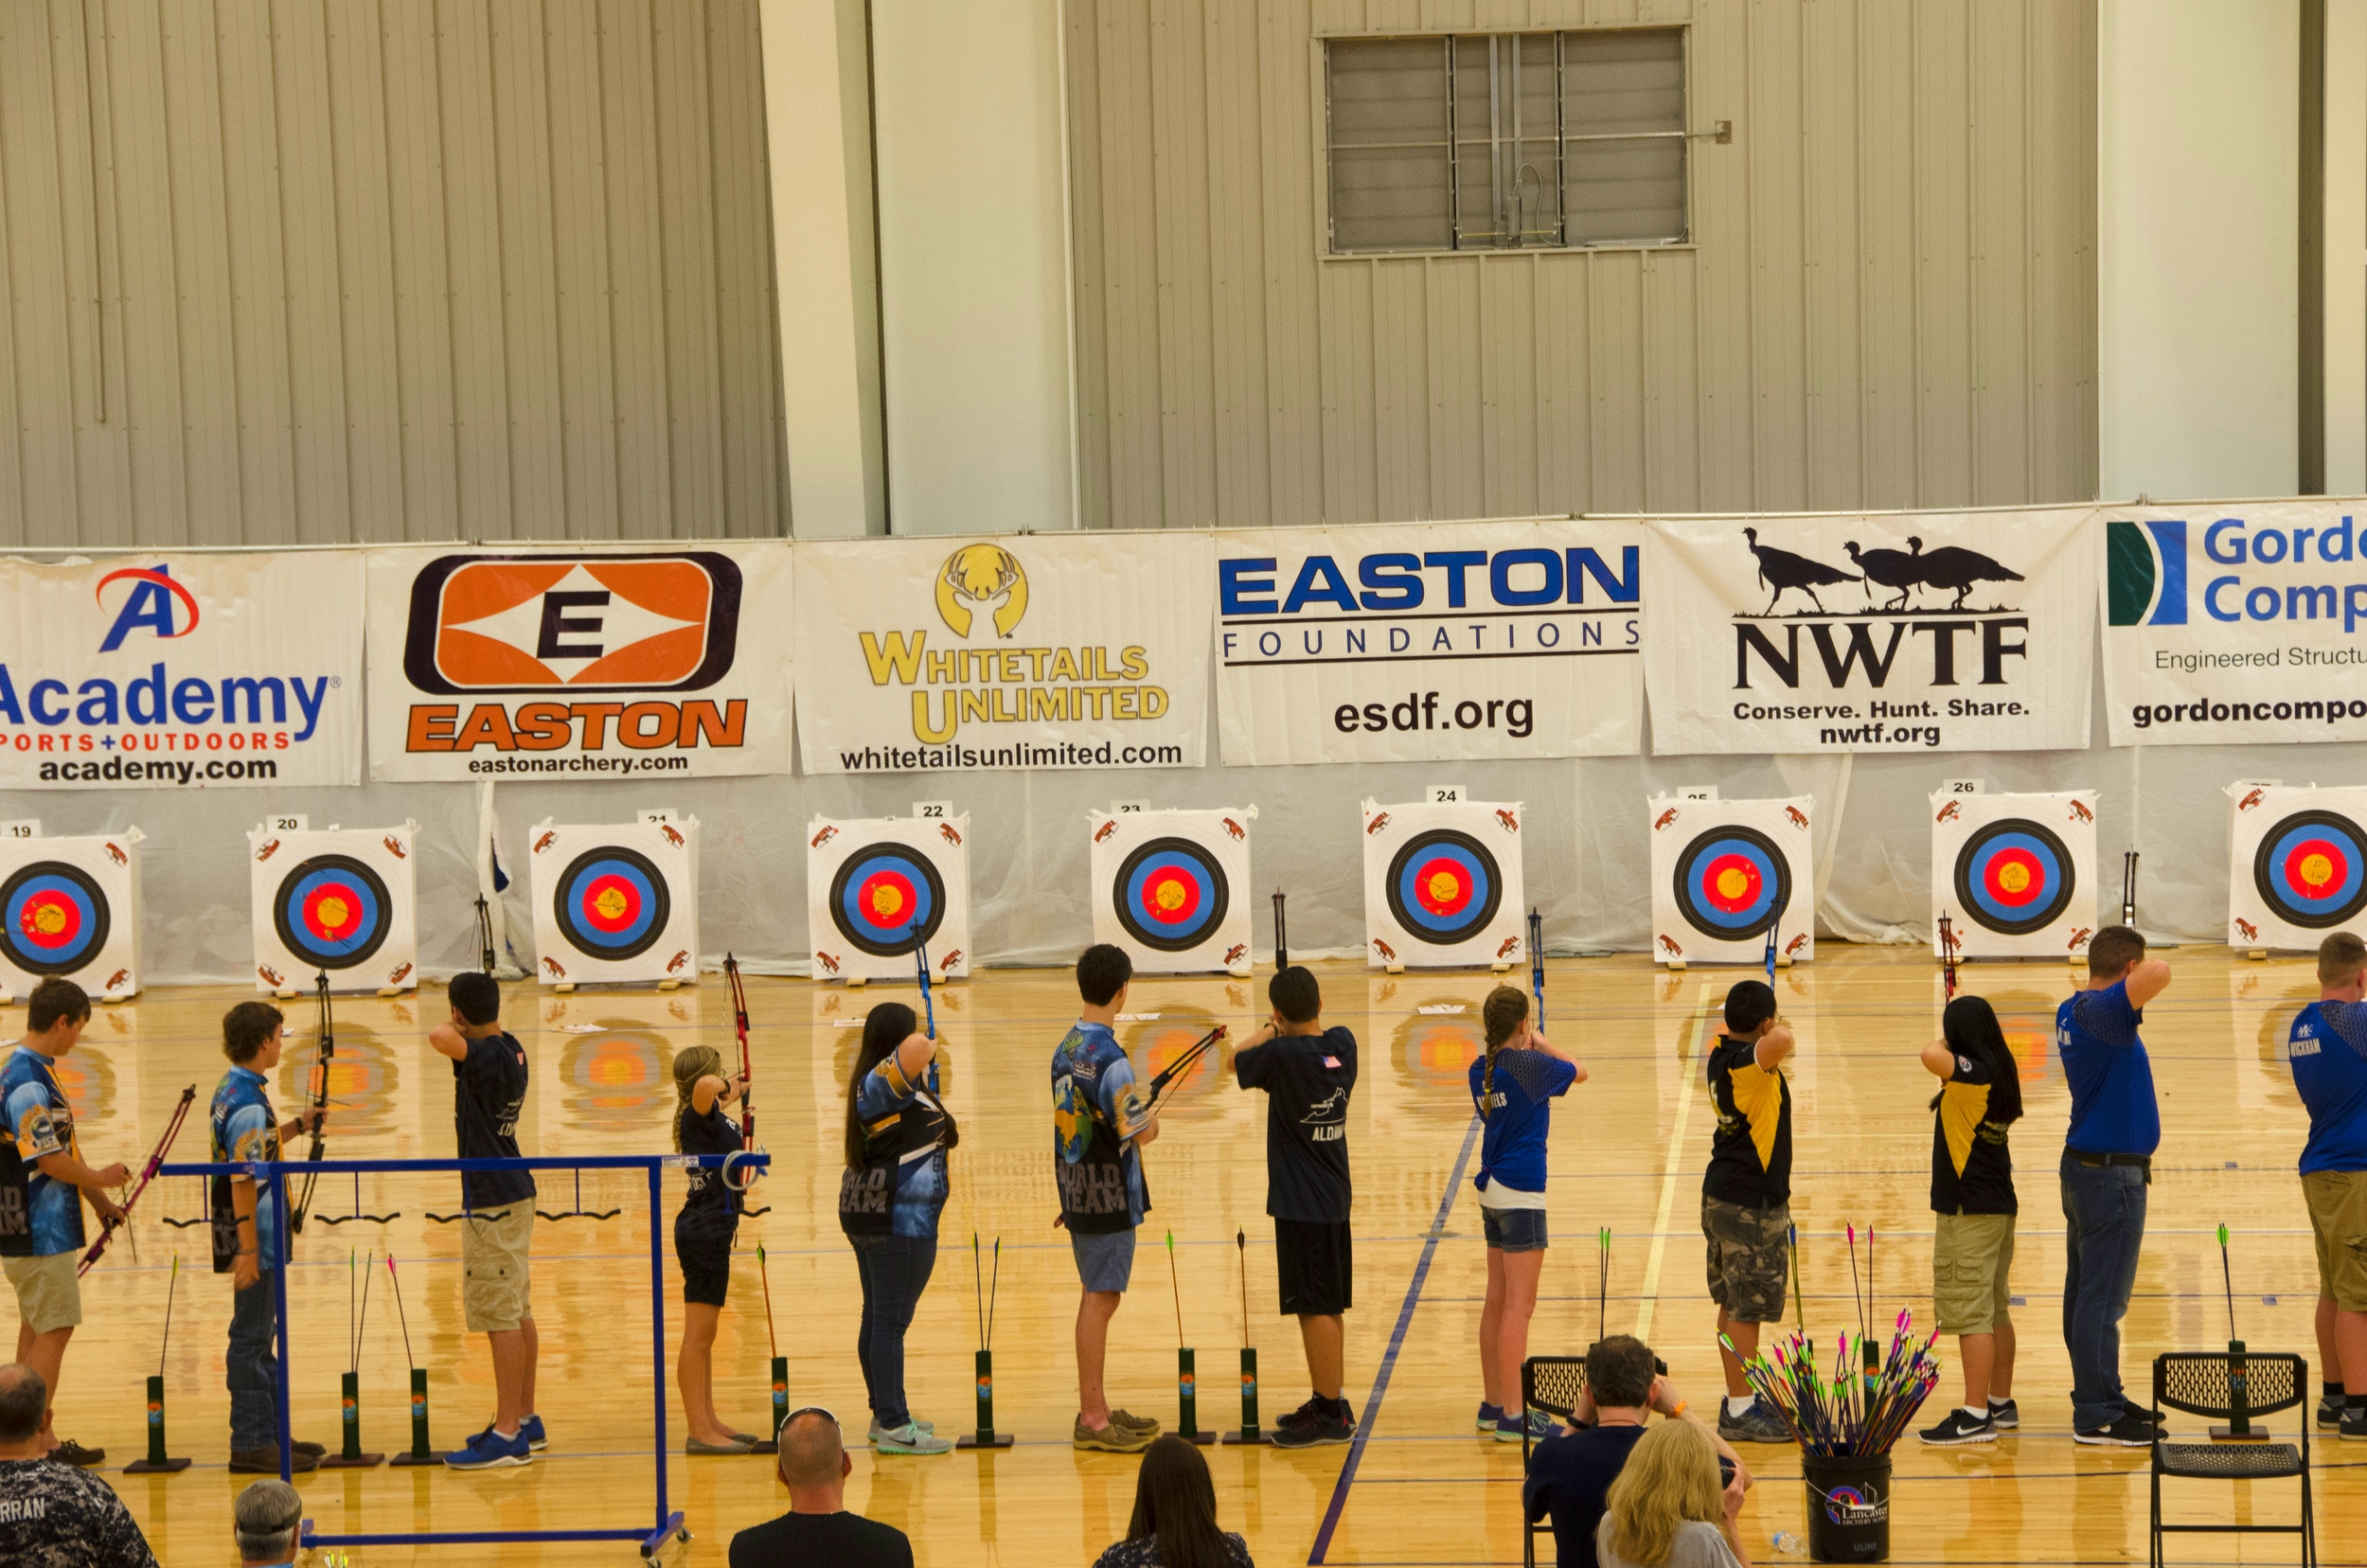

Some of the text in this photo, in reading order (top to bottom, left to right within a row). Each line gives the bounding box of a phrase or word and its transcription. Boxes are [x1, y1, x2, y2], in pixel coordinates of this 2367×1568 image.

[2204, 516, 2367, 564] Gord
[1219, 545, 1640, 615] EASTON
[536, 591, 611, 658] E
[1223, 620, 1640, 657] FOUNDATIONS
[1732, 617, 2029, 689] NWTF
[2155, 649, 2280, 673] Engineered
[1334, 691, 1534, 738] esdf.org
[1734, 699, 2030, 721] Conserve. Hunt. Share.
[405, 699, 748, 753] EASTON
[1820, 723, 1941, 746] nwtf.org
[469, 755, 688, 774] eastonarchery.com
[841, 742, 1182, 770] whitetailsunlimited.com
[40, 757, 276, 785] academy.com
[1436, 791, 1456, 802] 24
[1953, 782, 1974, 793] 26
[923, 806, 943, 817] 22
[11, 826, 31, 837] 19
[277, 819, 297, 829] 20
[1842, 1506, 1888, 1519] Lancaster
[1854, 1542, 1878, 1552] ULINE
